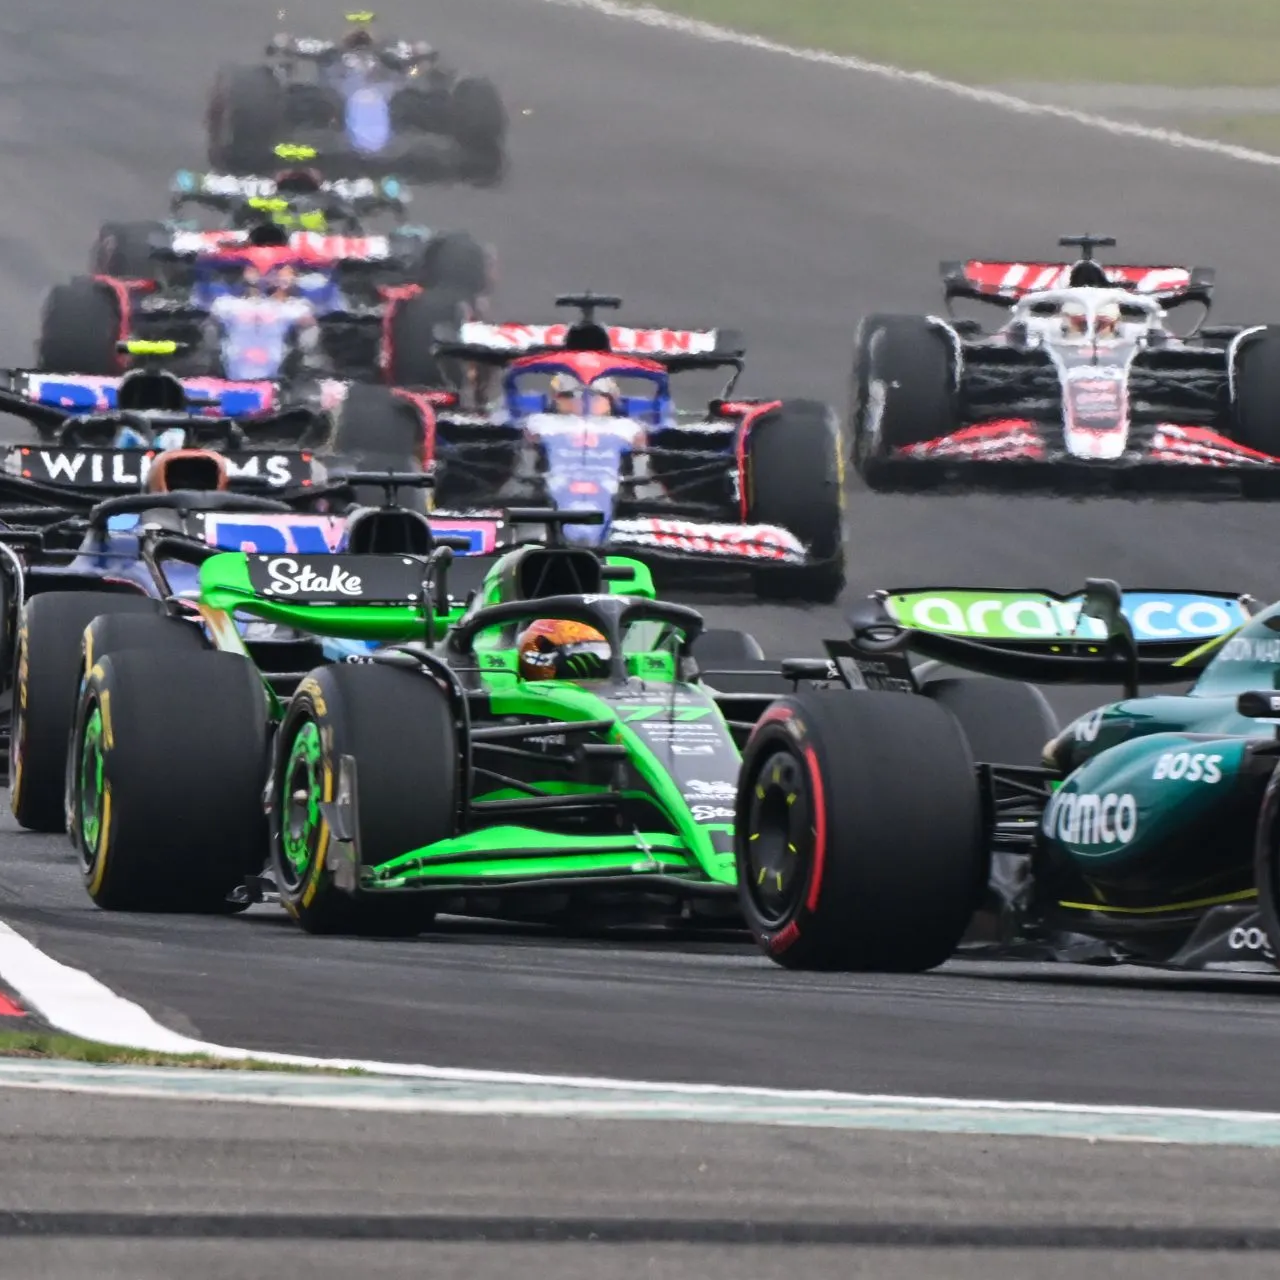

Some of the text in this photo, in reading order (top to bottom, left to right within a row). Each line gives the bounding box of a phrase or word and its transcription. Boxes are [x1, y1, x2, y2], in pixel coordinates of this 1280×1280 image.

[39, 451, 293, 487] WILMS
[268, 558, 364, 596] Stake
[911, 597, 1234, 637] aramco
[615, 706, 714, 724] 77
[1152, 753, 1224, 784] BOSS
